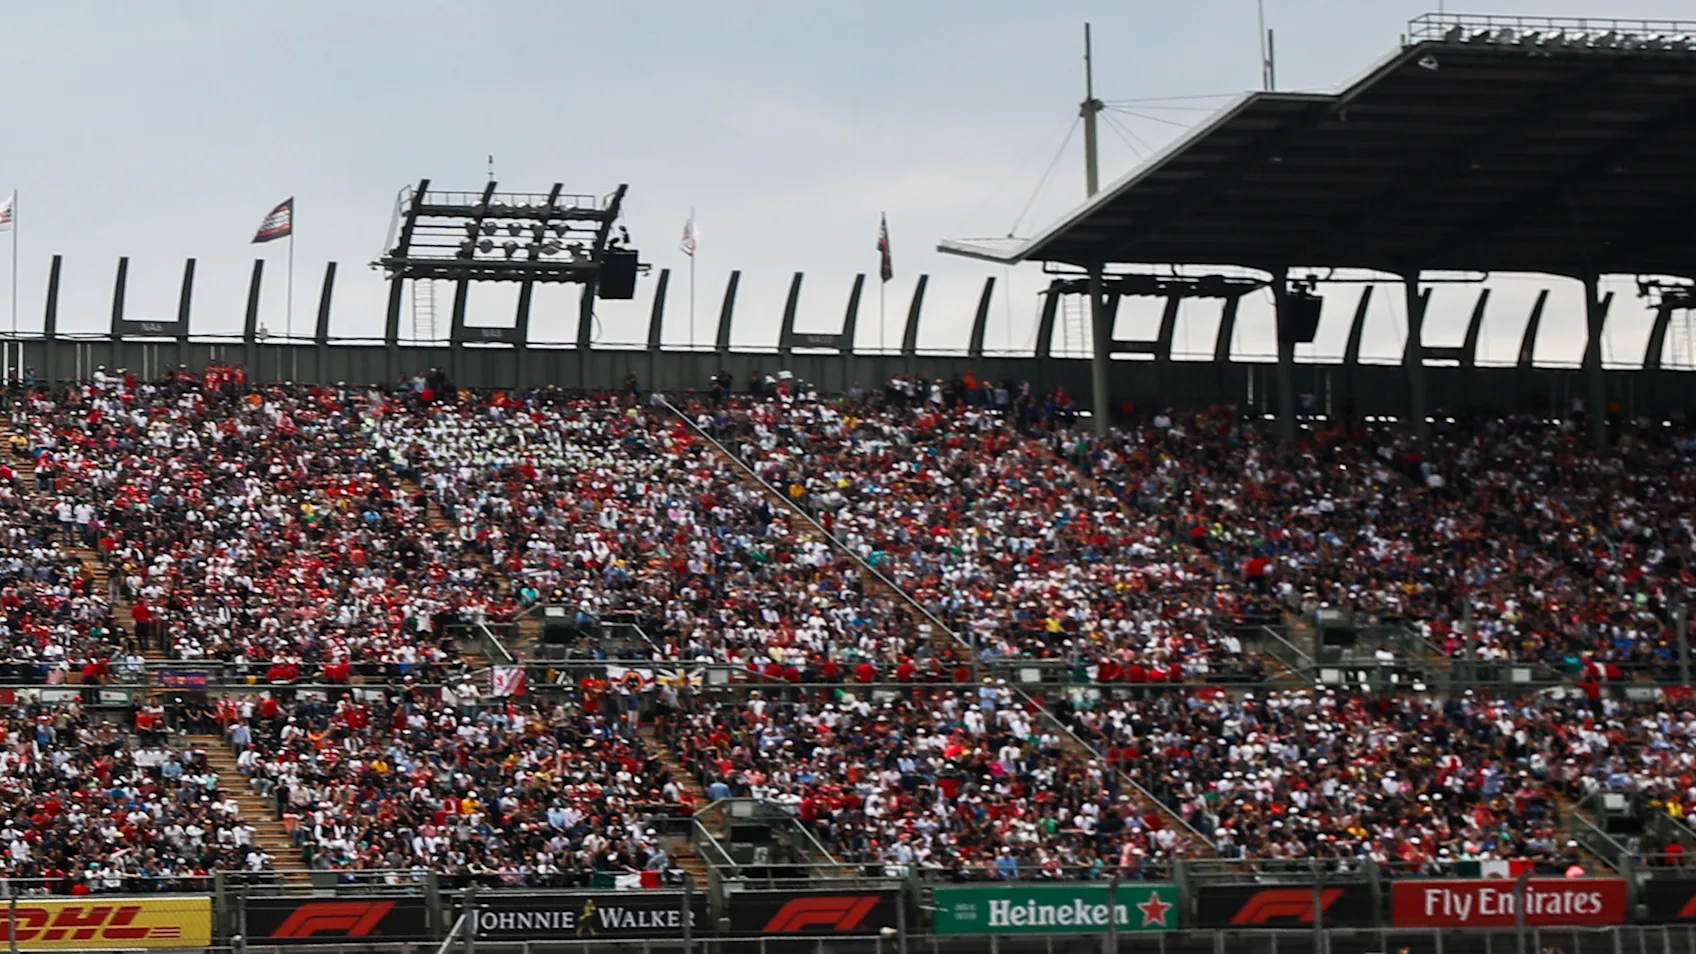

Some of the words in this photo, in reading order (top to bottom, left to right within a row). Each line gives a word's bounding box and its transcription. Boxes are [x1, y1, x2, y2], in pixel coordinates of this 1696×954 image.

[988, 898, 1129, 926] Heineken
[1424, 888, 1472, 921] Fly
[1478, 887, 1602, 915] Emirates
[471, 909, 575, 934] JOHNNIE
[598, 907, 696, 929] WALKER
